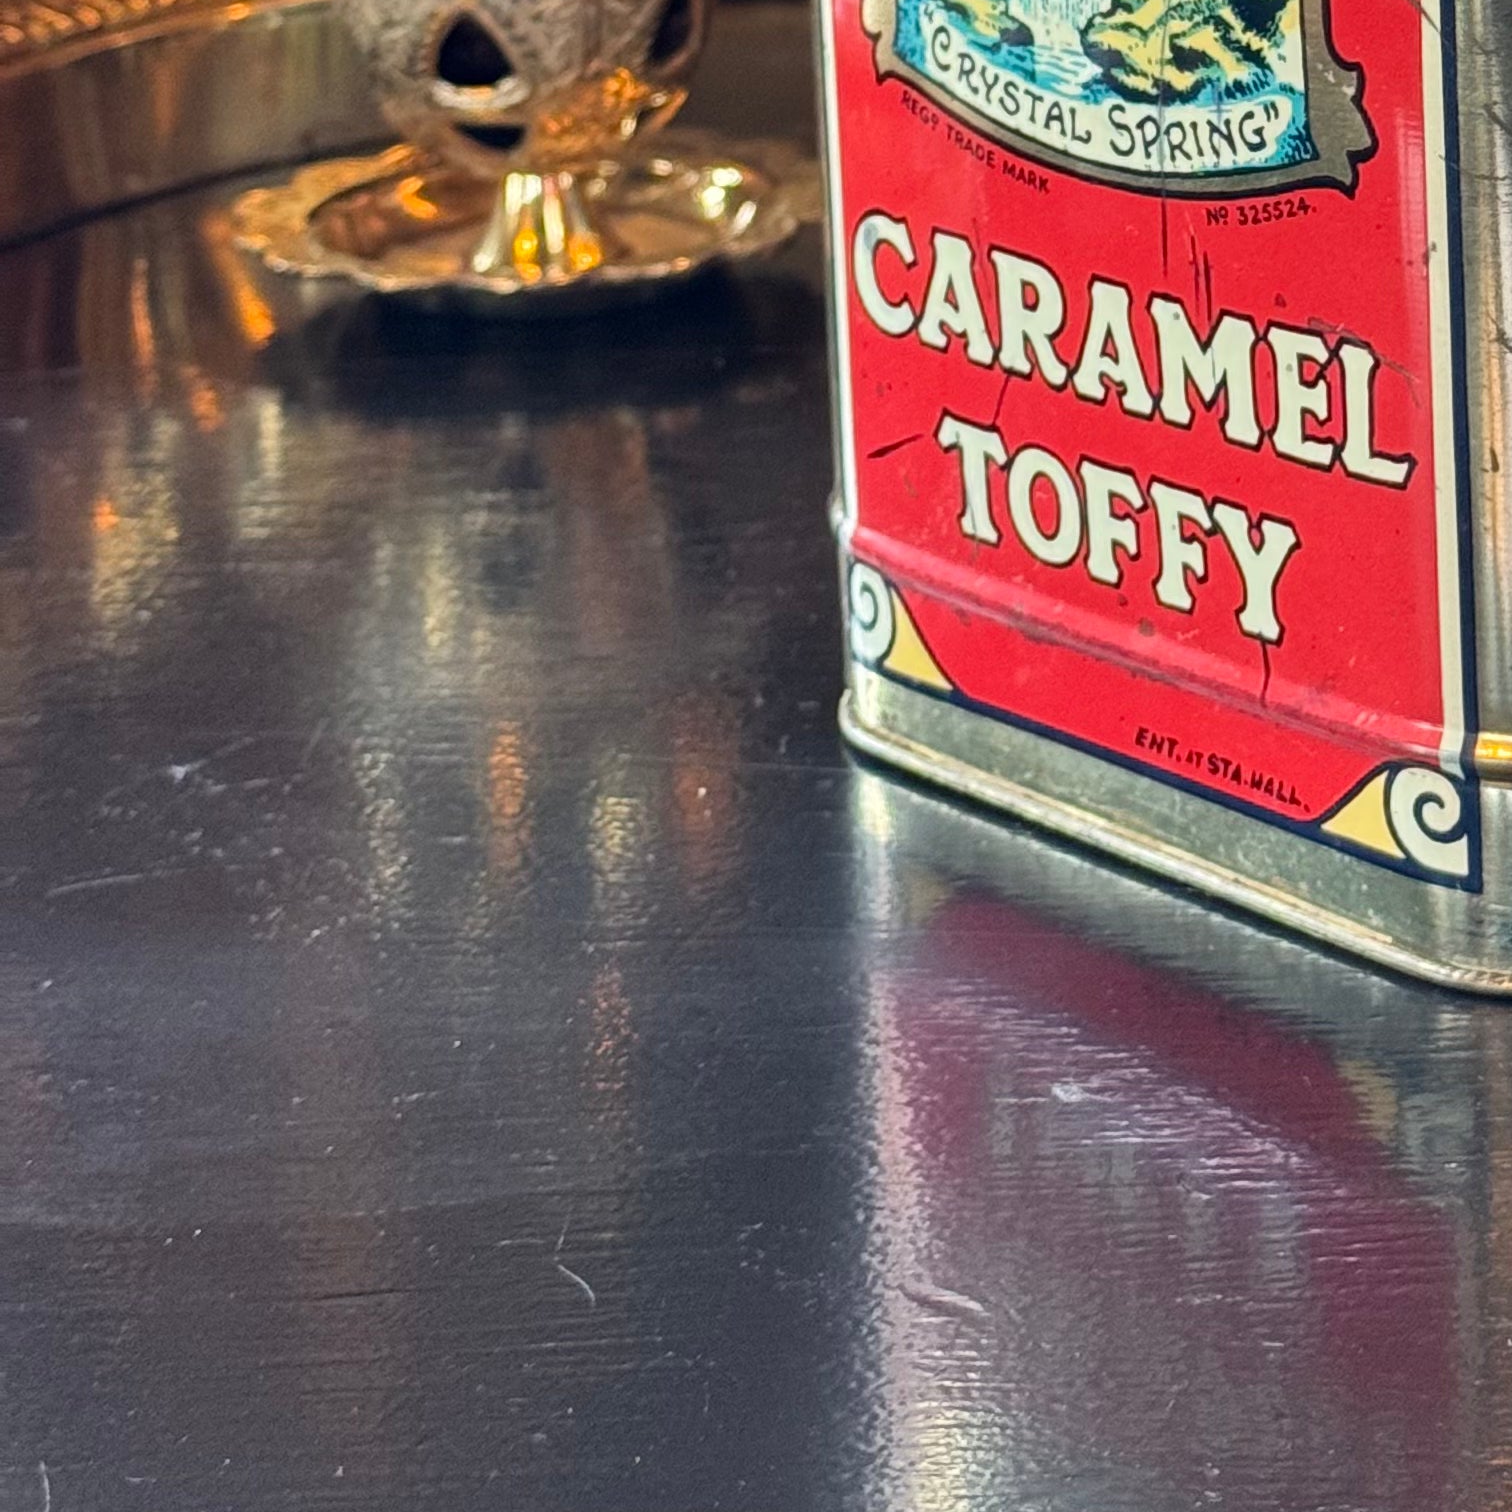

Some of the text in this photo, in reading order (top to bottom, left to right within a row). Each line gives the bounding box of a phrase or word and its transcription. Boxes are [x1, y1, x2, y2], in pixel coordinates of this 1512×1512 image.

[945, 124, 996, 169] TRADE
[1002, 160, 1050, 194] MARK
[852, 208, 1418, 490] CARAMEL
[933, 408, 1302, 646] TOFFY
